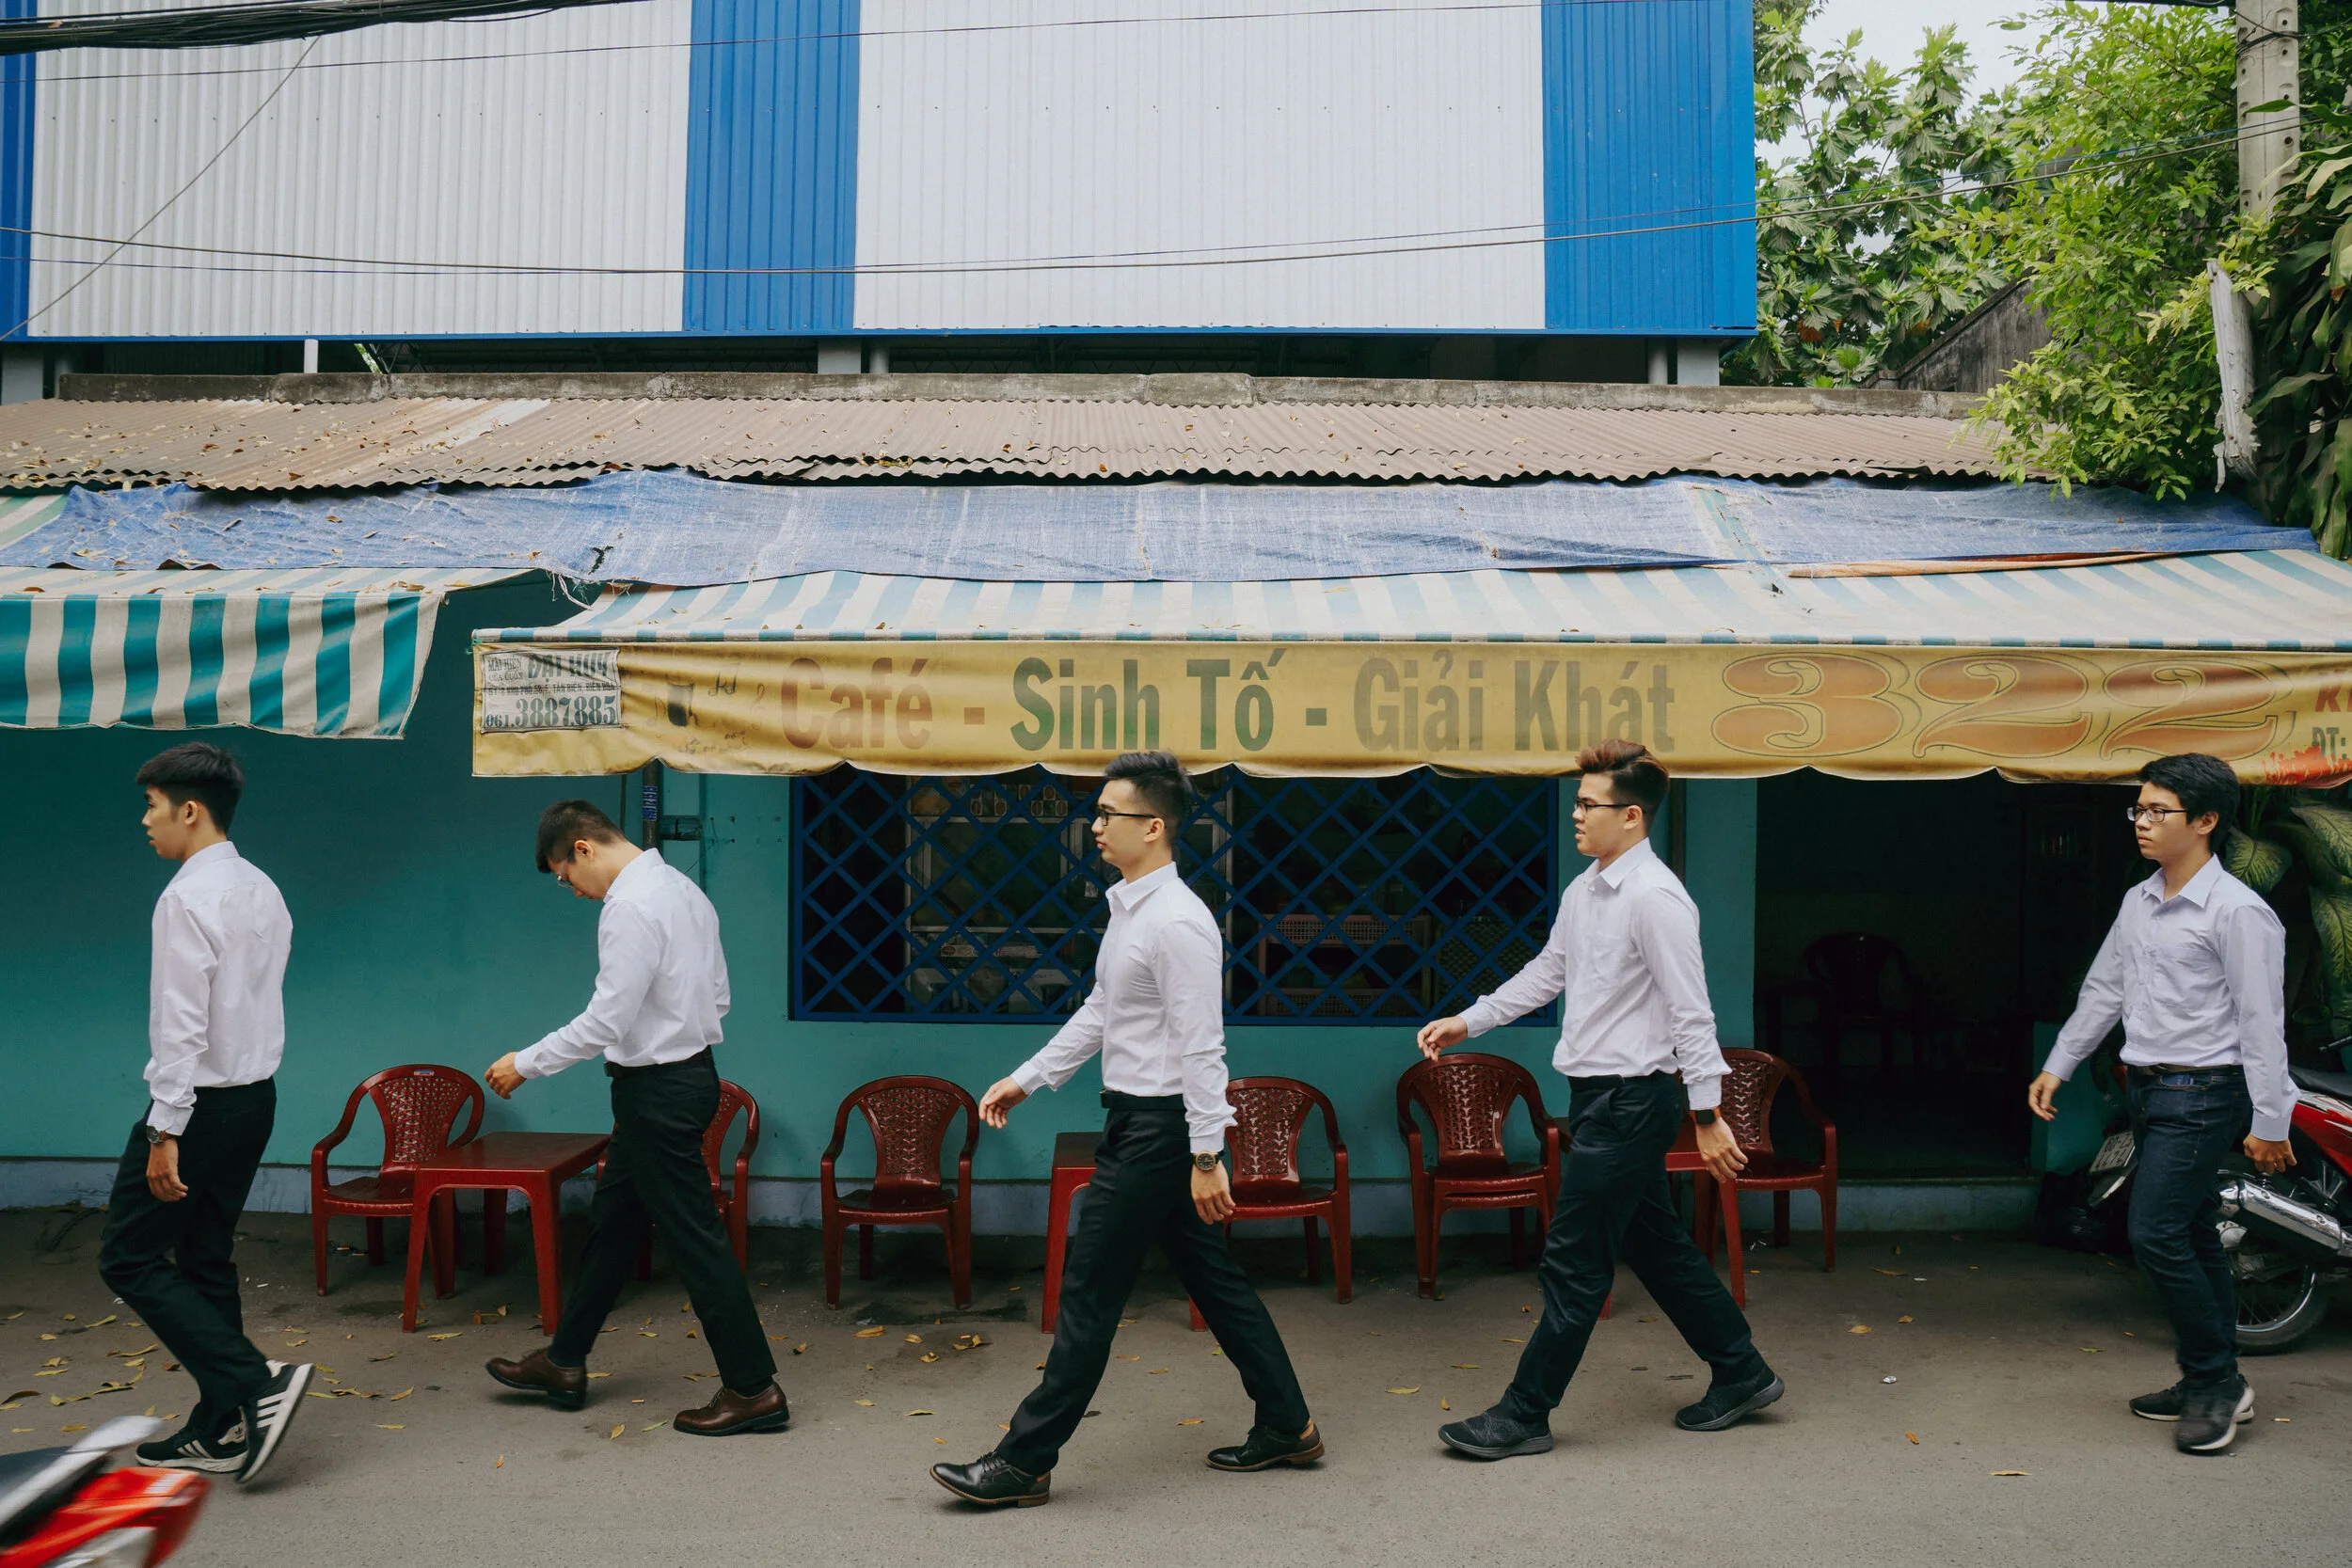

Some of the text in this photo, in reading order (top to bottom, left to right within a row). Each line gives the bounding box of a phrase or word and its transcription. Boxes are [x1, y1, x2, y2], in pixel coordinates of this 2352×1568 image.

[781, 657, 932, 750] Café
[1009, 657, 1160, 751] Sinh
[1186, 648, 1287, 751] Tố
[1354, 649, 1484, 752] Giải
[1514, 660, 1675, 752] Khát
[1711, 651, 2296, 761] 322
